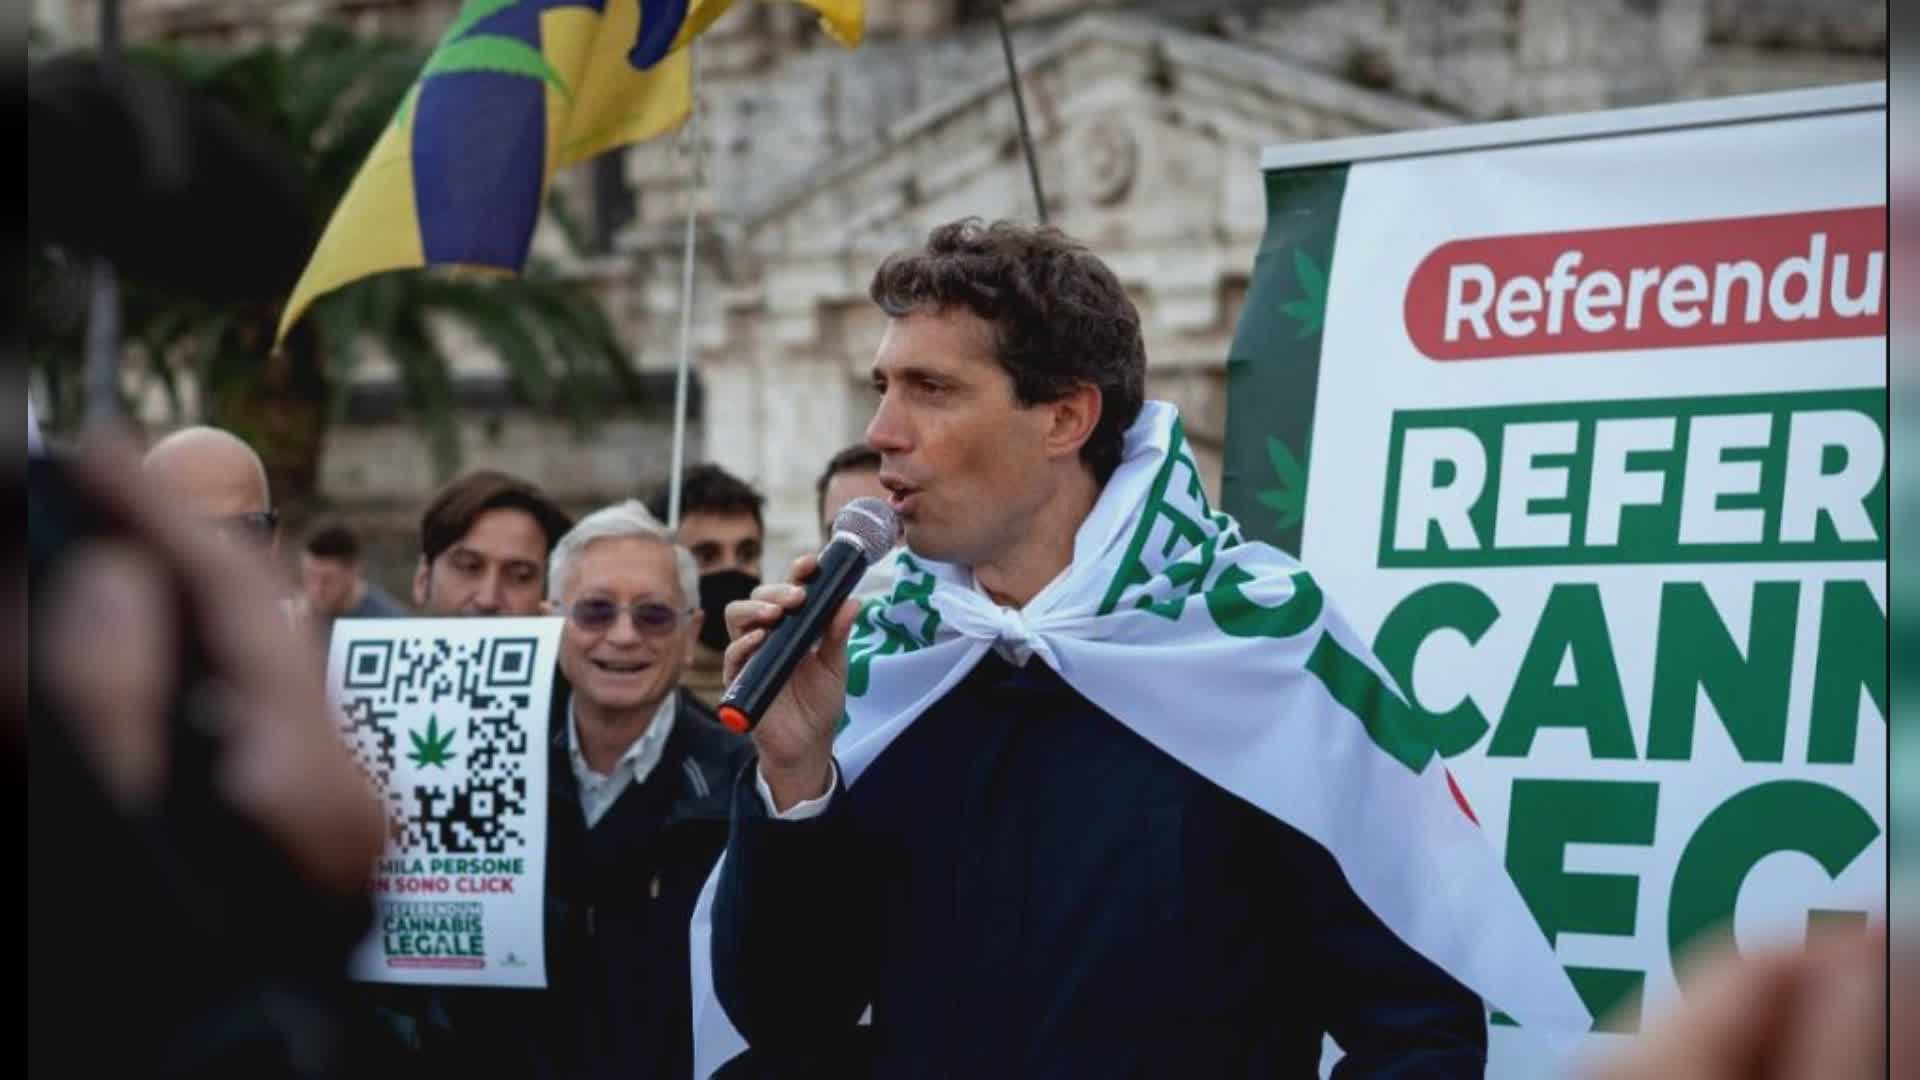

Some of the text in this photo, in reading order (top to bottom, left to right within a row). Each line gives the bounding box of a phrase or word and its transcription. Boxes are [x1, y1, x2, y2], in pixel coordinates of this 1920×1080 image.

[1393, 409, 1886, 550] REFER
[431, 858, 524, 874] PERSONE
[395, 877, 449, 892] SONO
[456, 877, 514, 893] CLICK
[384, 916, 482, 932] CANNABIS
[384, 935, 485, 955] LEGALE
